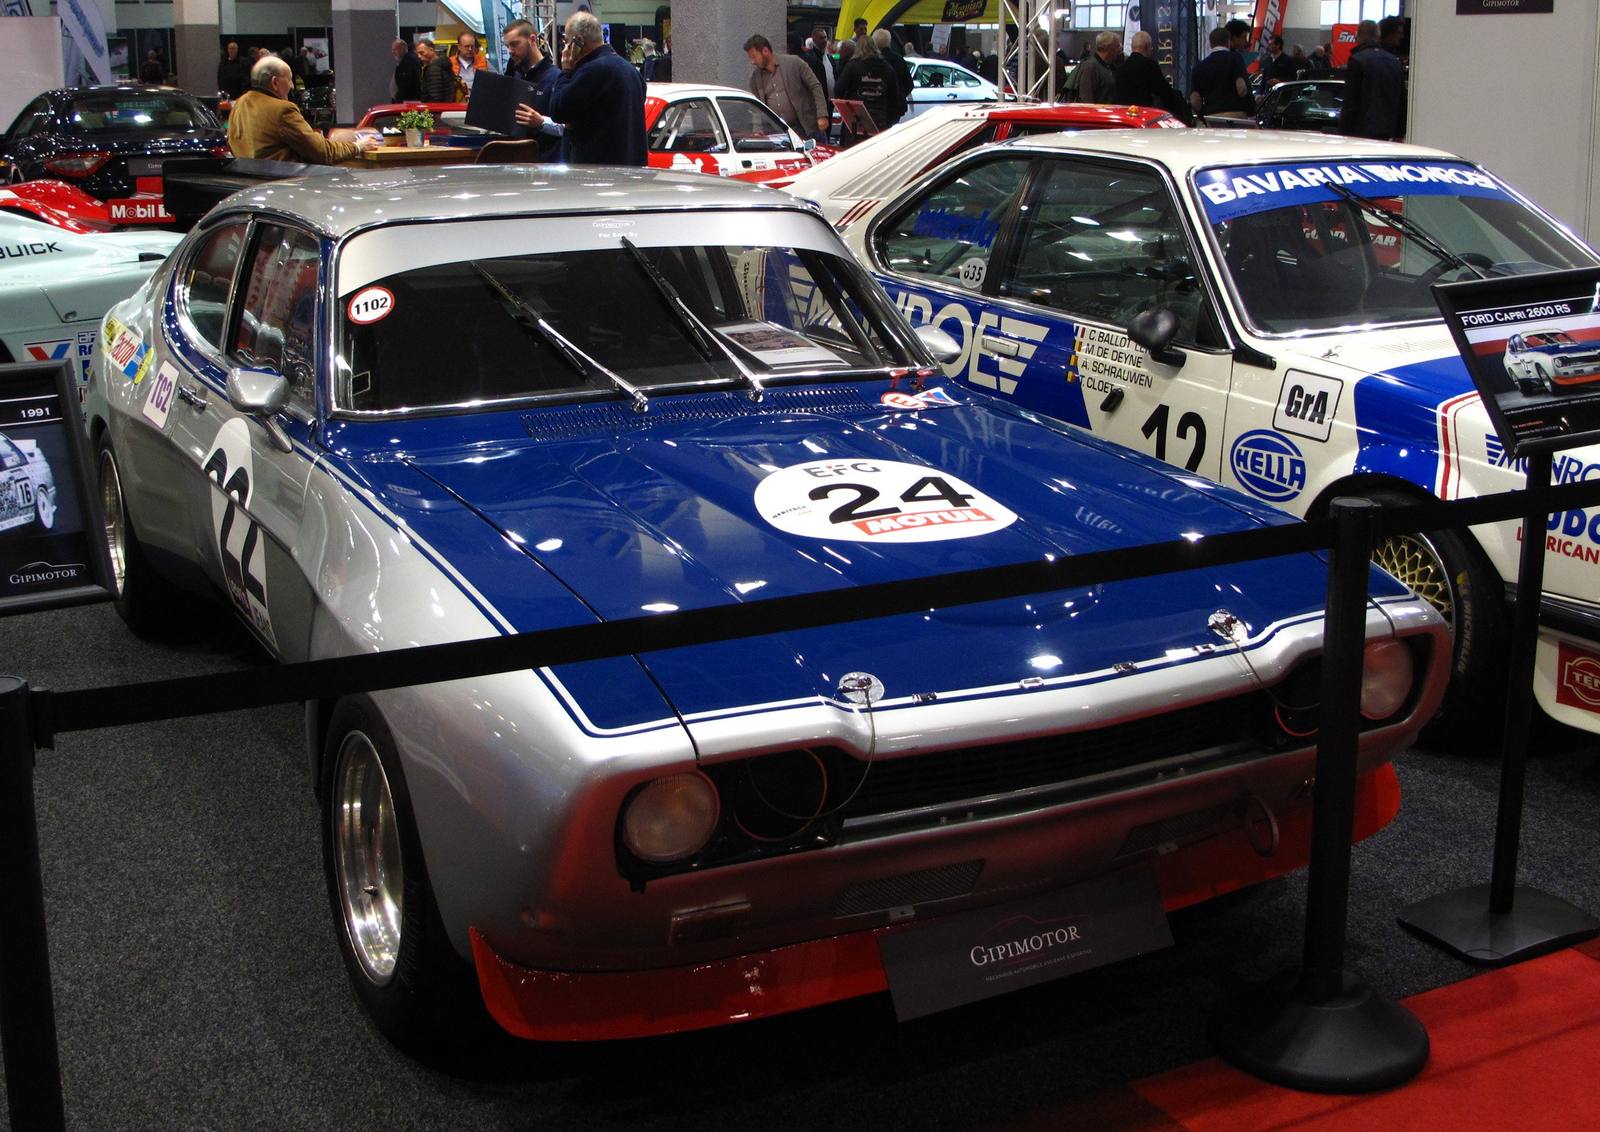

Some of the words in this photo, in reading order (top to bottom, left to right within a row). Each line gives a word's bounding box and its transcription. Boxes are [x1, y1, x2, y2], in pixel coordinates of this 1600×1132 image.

[1200, 166, 1369, 205] BAVARIA
[1378, 163, 1498, 190] MONROE
[111, 204, 156, 219] Mobil
[354, 296, 389, 316] 1102
[1459, 312, 1493, 326] FORD
[1525, 304, 1554, 319] 2600
[1554, 302, 1571, 315] RS
[1111, 350, 1143, 368] DEYNE
[1091, 361, 1154, 388] SCHRAUWEN
[150, 373, 173, 413] TC2
[1284, 384, 1329, 425] GrA
[20, 407, 52, 419] 1991
[1141, 404, 1207, 473] 12
[802, 462, 881, 478] EFG
[1235, 448, 1306, 491] HELLA
[20, 481, 32, 504] 16
[808, 476, 975, 524] 24
[867, 509, 987, 532] MOTUL
[9, 568, 77, 585] GIPIMOTOR
[970, 926, 1081, 966] GIPIMOTOR
